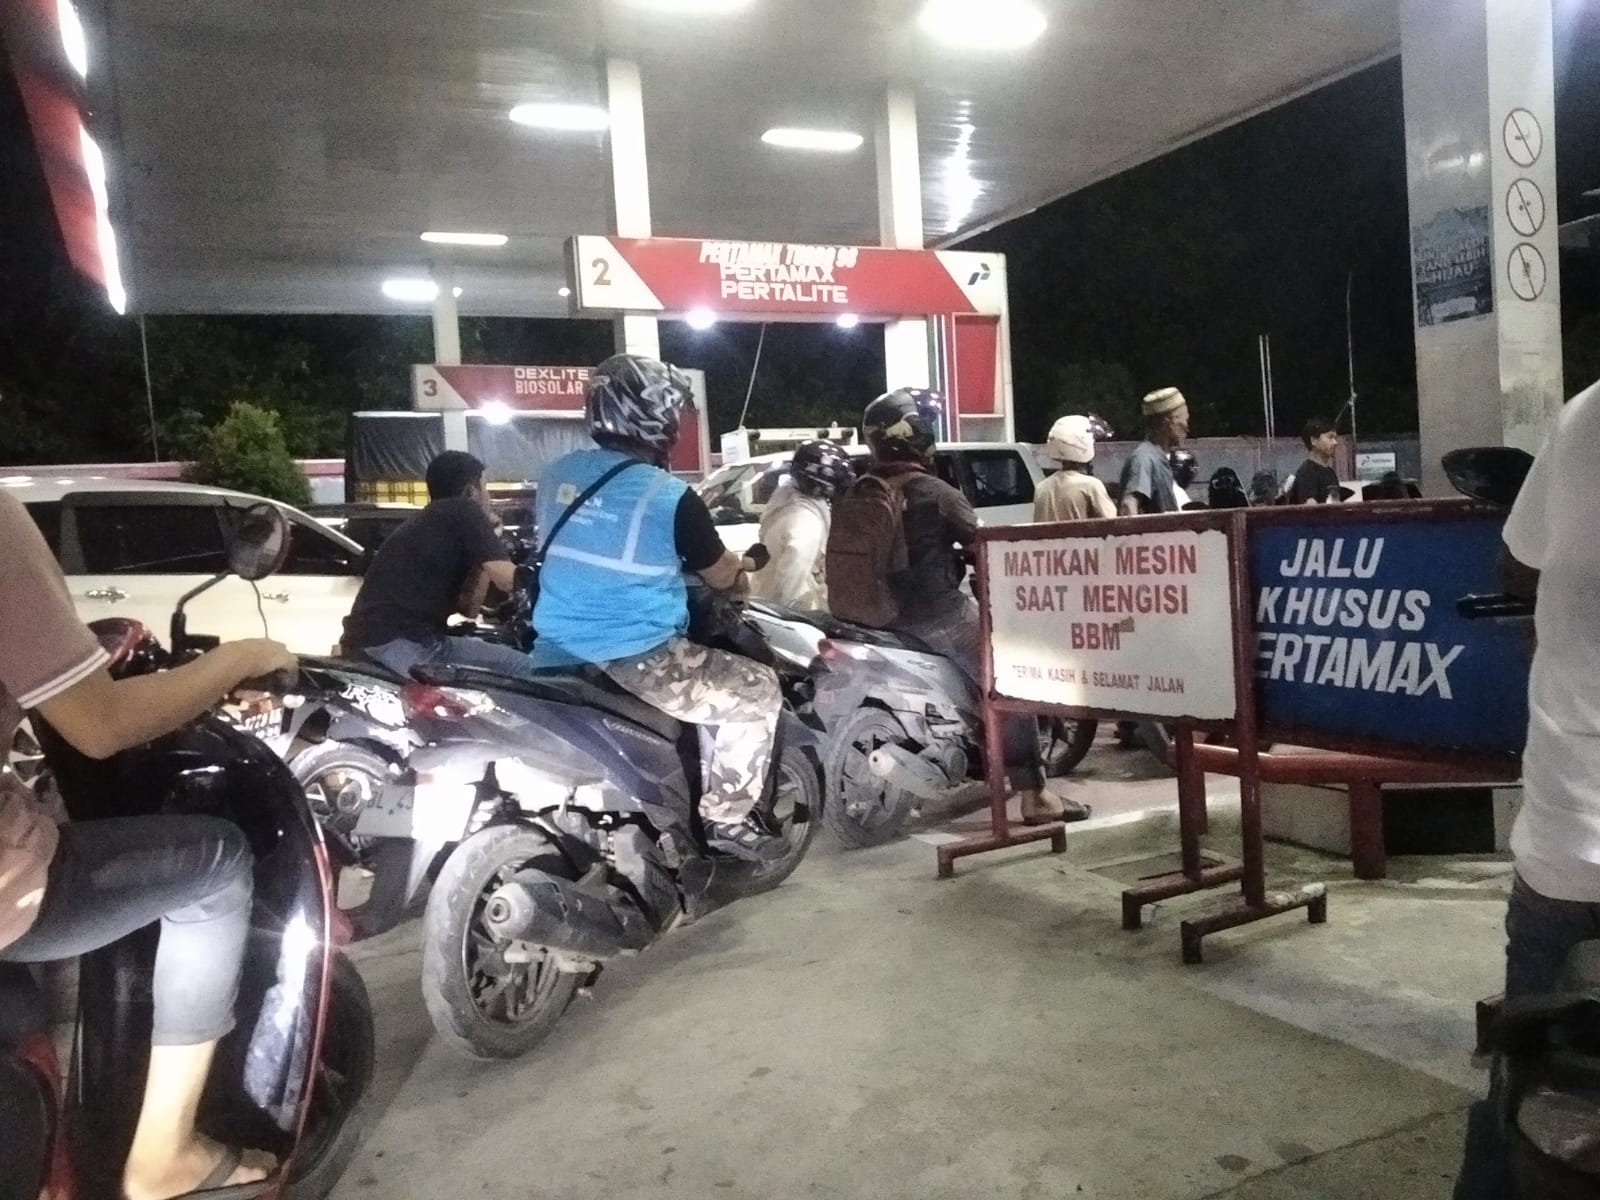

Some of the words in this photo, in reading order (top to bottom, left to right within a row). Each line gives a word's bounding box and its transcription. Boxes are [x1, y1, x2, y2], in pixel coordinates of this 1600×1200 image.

[591, 258, 611, 286] 2
[720, 264, 835, 283] PERTAMAX
[720, 280, 849, 303] PERTALITE
[423, 379, 438, 397] 3
[514, 367, 589, 381] DEXLITE
[515, 380, 584, 395] BIOSOLAR
[1004, 547, 1099, 577] MATIKAN
[1115, 544, 1197, 575] MESIN
[1280, 537, 1385, 579] JALU
[1015, 585, 1068, 612] SAAT
[1083, 584, 1189, 614] MENGISI
[1256, 586, 1431, 632] KHUSUS
[1071, 622, 1121, 650] BBM
[1012, 664, 1043, 680] TERMA
[1048, 667, 1076, 683] KASIH
[1082, 670, 1088, 685] &
[1093, 672, 1140, 690] SELAMAT
[1147, 675, 1185, 694] JALAN
[1257, 631, 1465, 700] ERTAMAX
